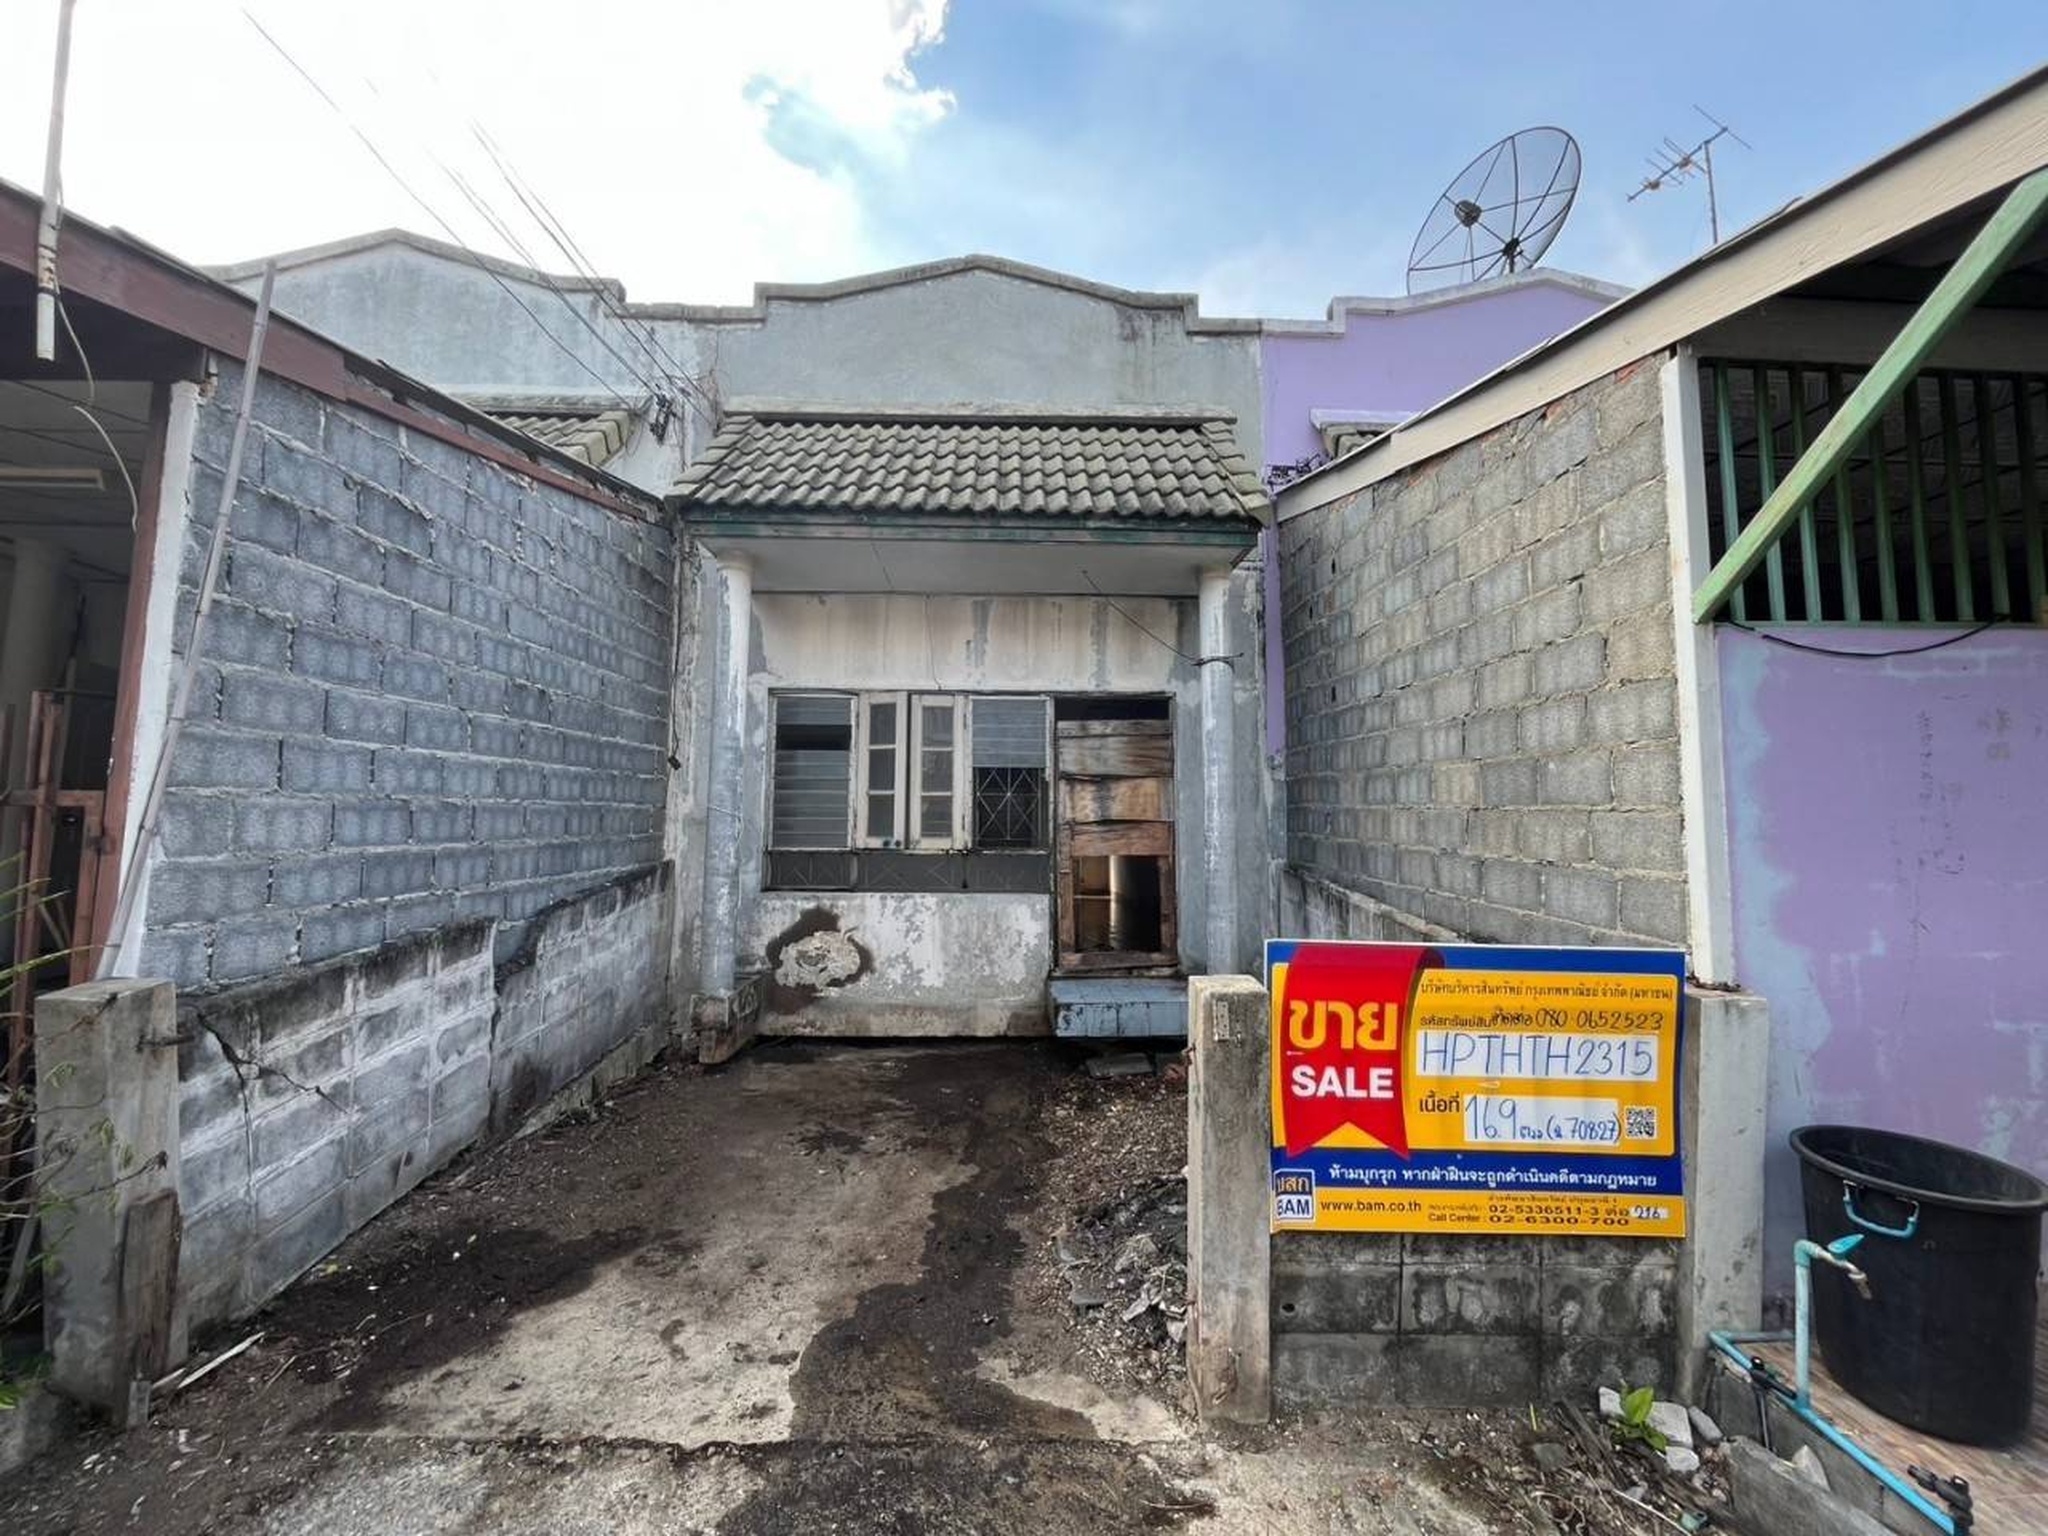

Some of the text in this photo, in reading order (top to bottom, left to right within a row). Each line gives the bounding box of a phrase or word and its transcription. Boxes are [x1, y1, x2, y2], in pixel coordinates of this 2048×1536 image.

[1601, 982, 1627, 998] จำกัด
[1630, 987, 1673, 1002] (มหาชน)
[1289, 1000, 1398, 1051] ขาย
[1576, 1010, 1664, 1030] 0652523
[1423, 1032, 1653, 1076] HPTHTH2315
[1290, 1065, 1395, 1099] SALE
[1419, 1089, 1460, 1113] เนื้อที่
[1328, 1164, 1396, 1185] ห้ามบุกรุก
[1321, 1199, 1422, 1213] www.bam.co.th
[1489, 1204, 1599, 1217] 02-5336511-3
[1489, 1214, 1629, 1227] 02-6300-700
